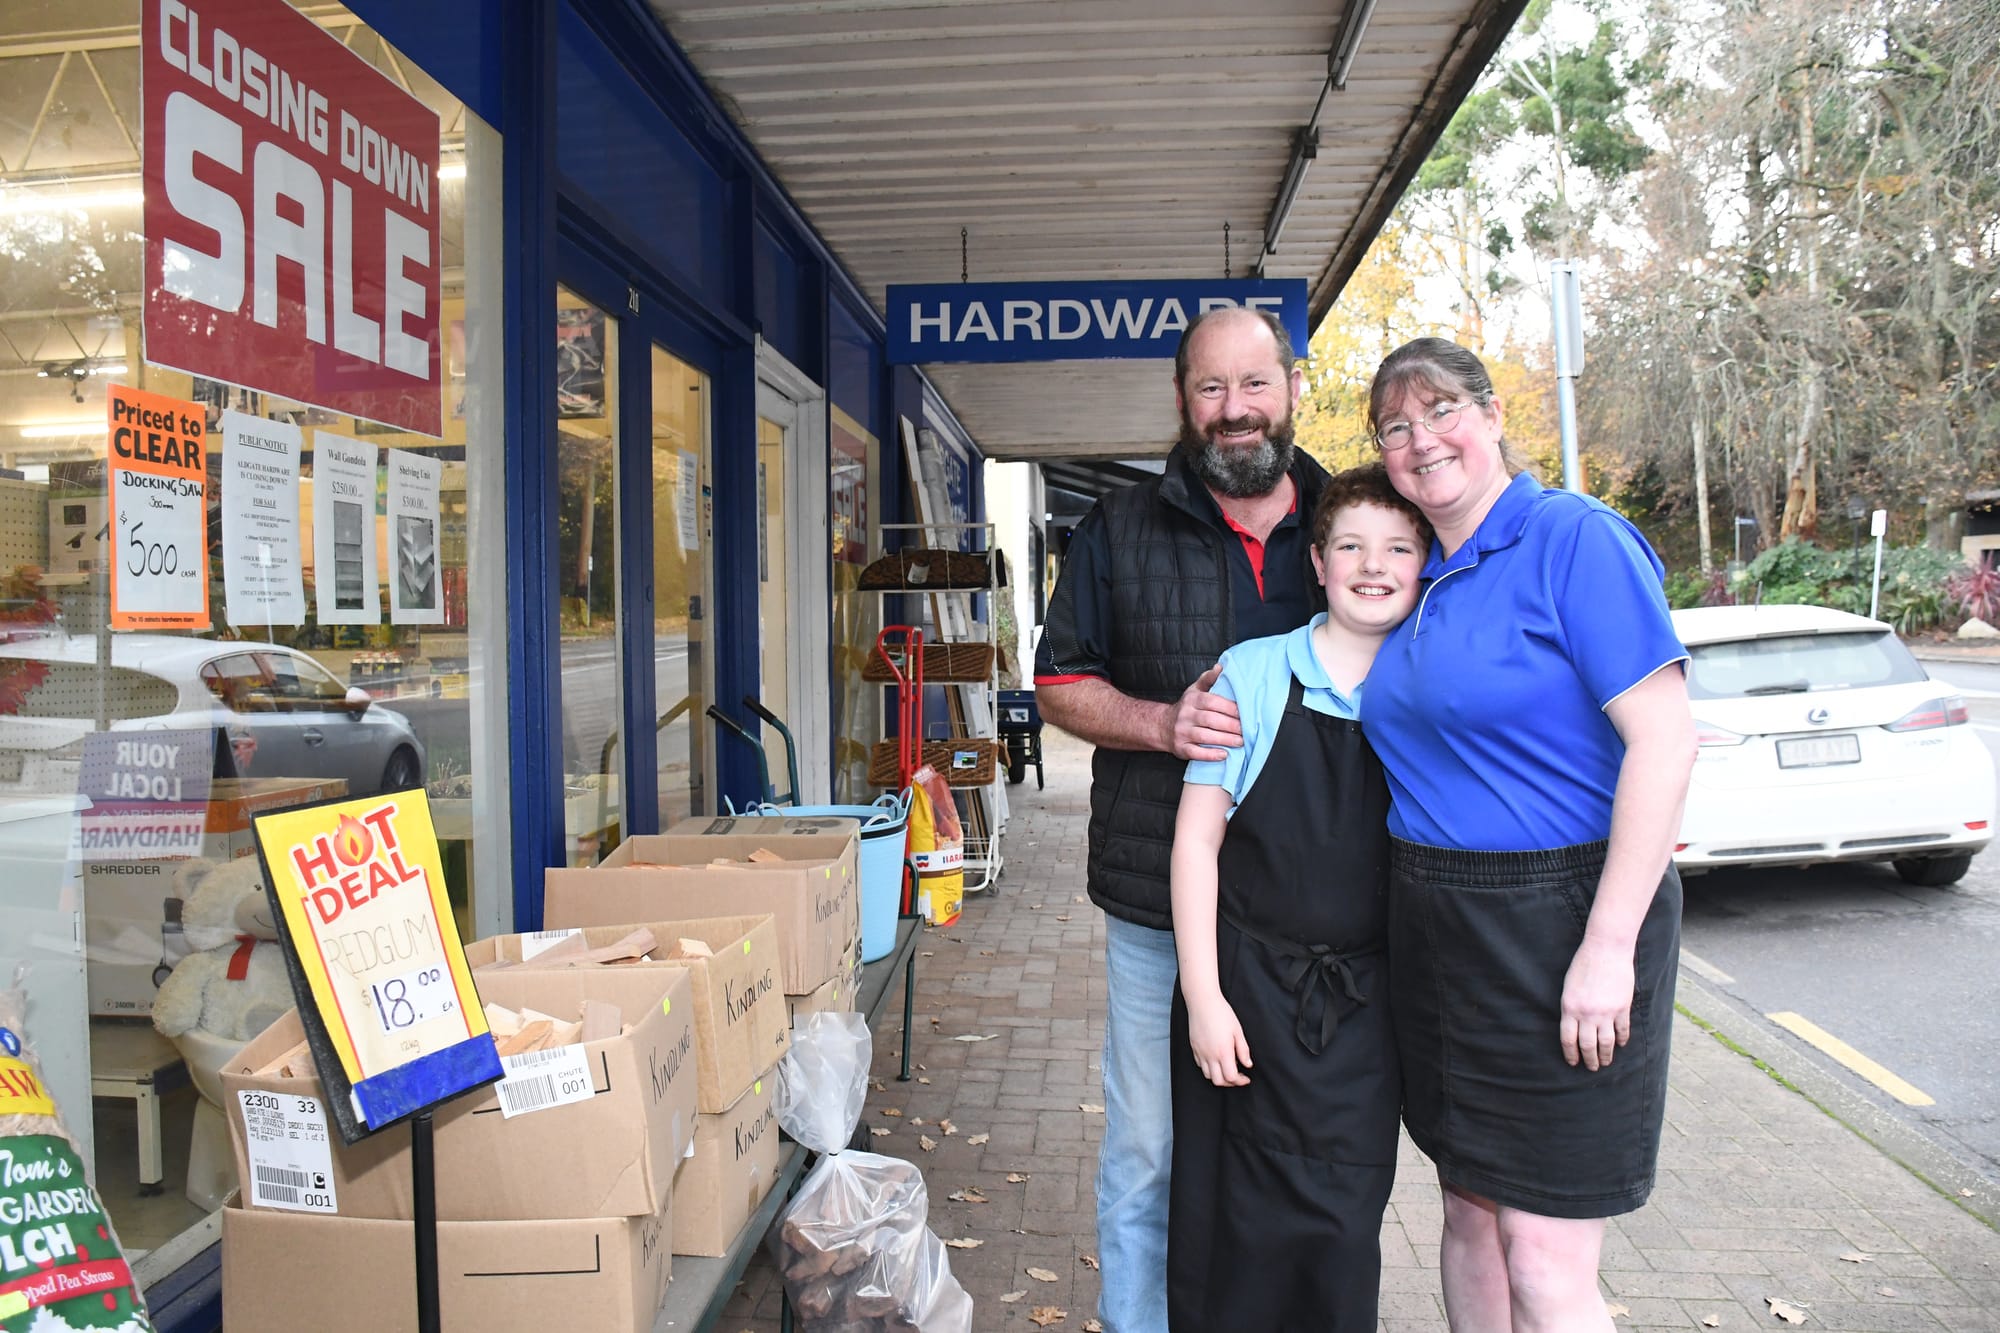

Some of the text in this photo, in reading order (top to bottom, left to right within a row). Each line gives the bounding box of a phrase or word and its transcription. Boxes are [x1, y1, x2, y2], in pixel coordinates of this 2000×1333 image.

[160, 0, 429, 215] CLOSING DOWN
[164, 90, 430, 380] SALE
[909, 296, 1284, 343] HARDWA
[113, 398, 201, 437] Priced to
[114, 427, 201, 470] CLEAR
[238, 433, 288, 452] PUBLIC NOTICE
[328, 449, 366, 467] Wall Gondola
[122, 471, 177, 496] DOCKING
[178, 477, 205, 498] SAW
[293, 805, 395, 889] HOT
[91, 865, 160, 875] SHREDDER
[310, 851, 420, 924] DEAL
[323, 914, 436, 979] REDGUM
[725, 968, 772, 1027] KINDLING
[558, 1066, 583, 1079] CHUTE
[649, 1025, 690, 1104] KINDLING
[244, 1094, 279, 1110] 2300
[297, 1100, 316, 1113] 33
[562, 1077, 587, 1095] 001
[735, 1100, 774, 1161] KINDLIN
[0, 1146, 72, 1188] Tom's
[0, 1187, 99, 1226] GARDEN
[304, 1193, 333, 1207] 001
[0, 1222, 77, 1273] LCH
[56, 1273, 82, 1291] Pea
[80, 1269, 115, 1286] Straw
